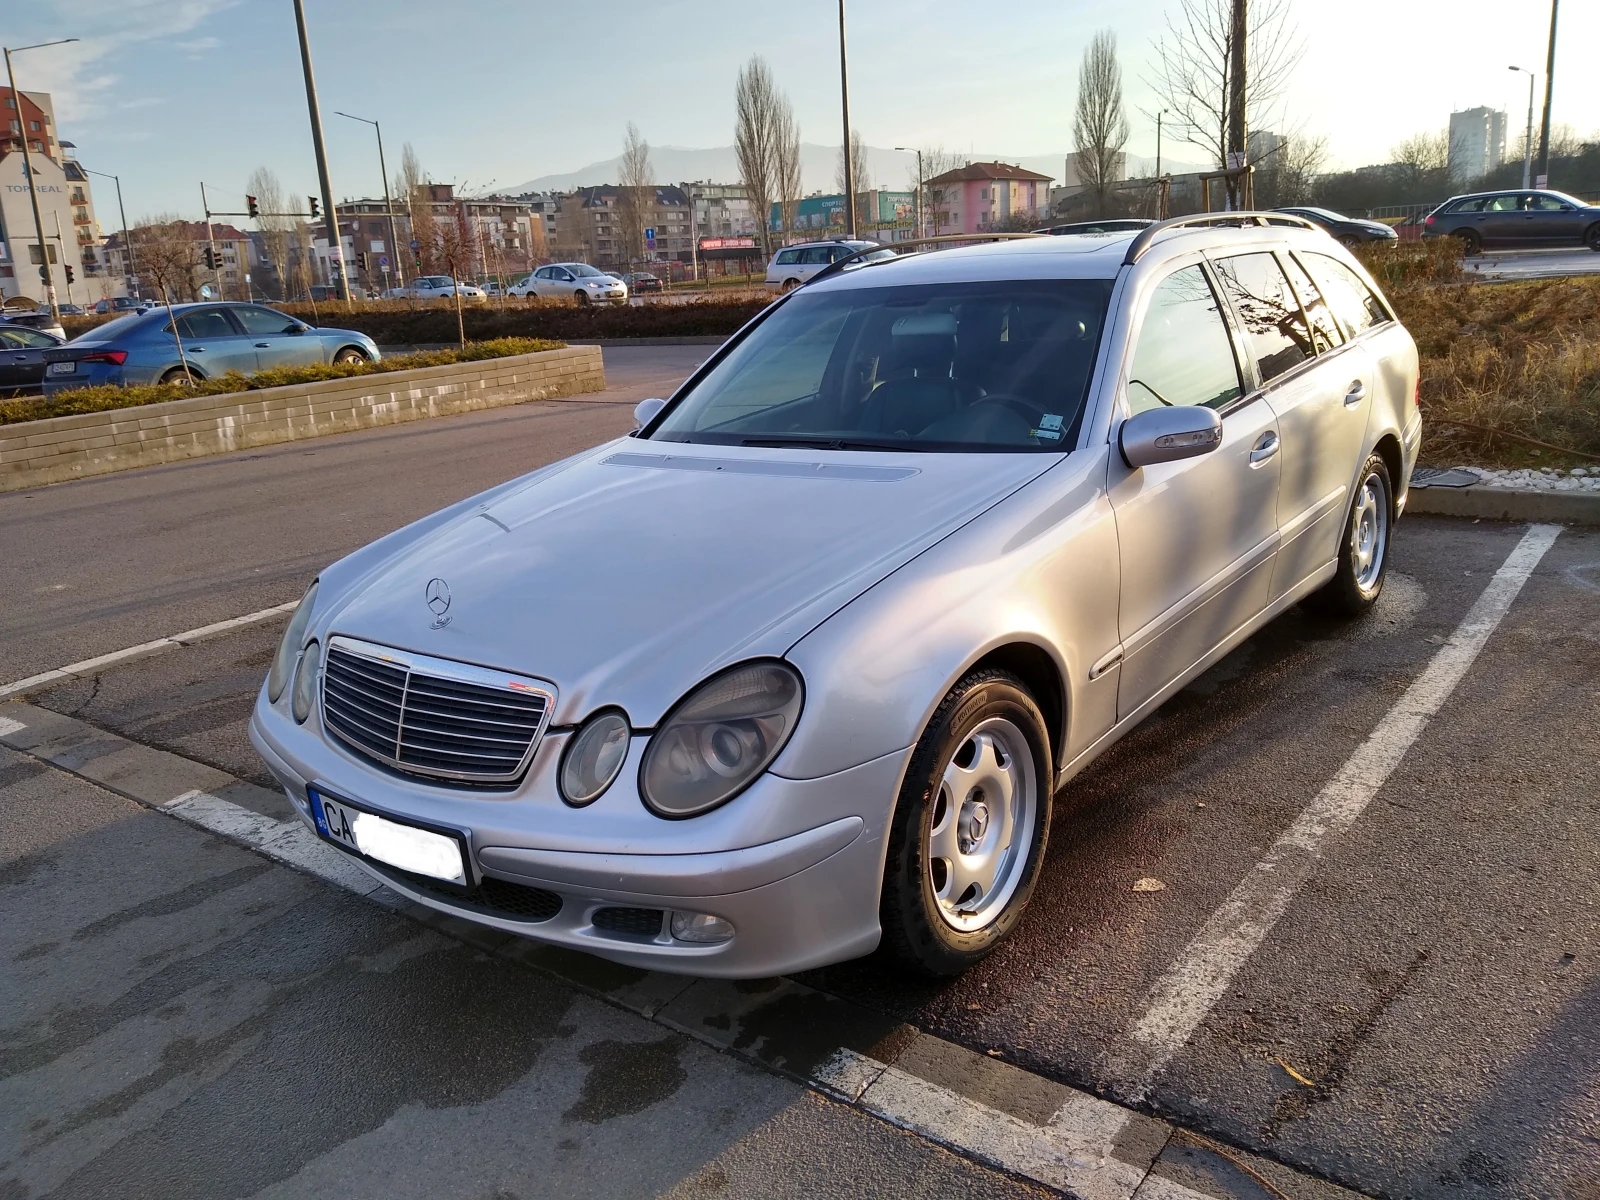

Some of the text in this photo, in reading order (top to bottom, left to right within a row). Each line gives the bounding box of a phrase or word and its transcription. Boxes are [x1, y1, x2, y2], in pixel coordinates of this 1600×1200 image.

[6, 185, 63, 193] TOP REAL
[317, 816, 327, 830] BG
